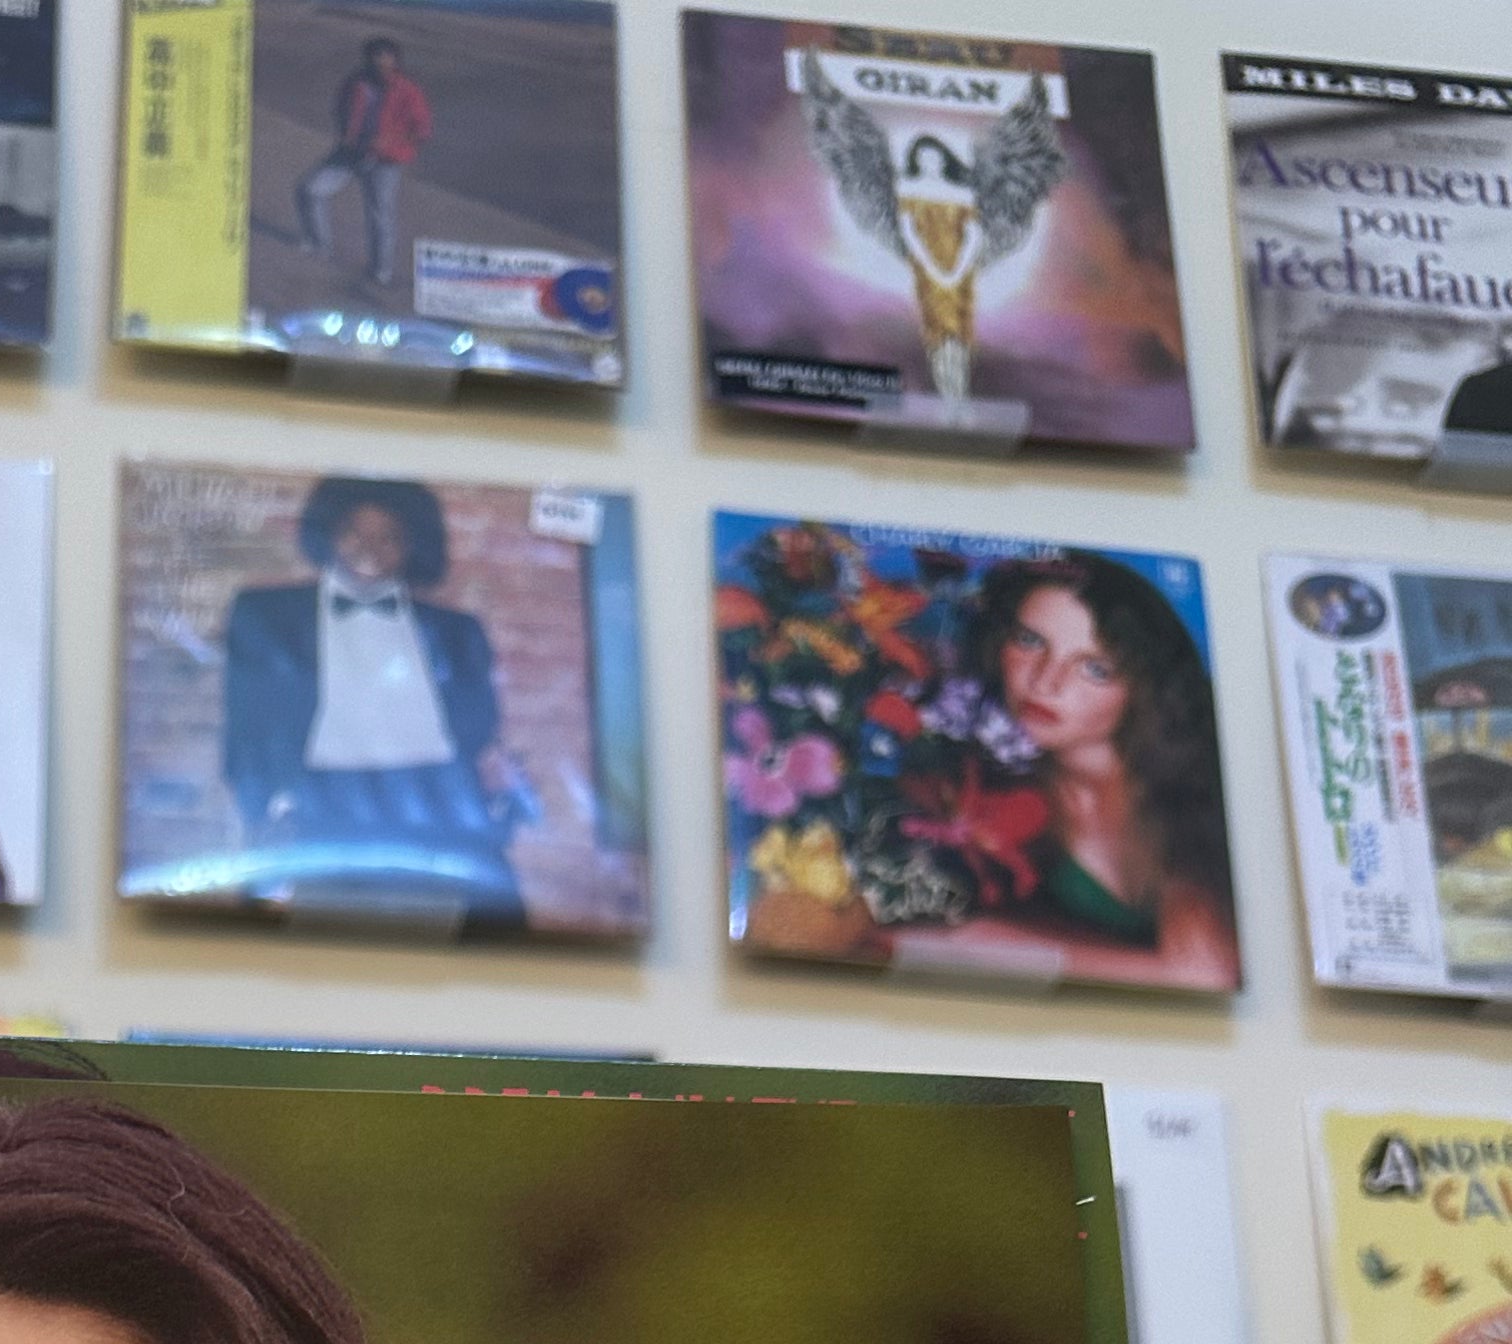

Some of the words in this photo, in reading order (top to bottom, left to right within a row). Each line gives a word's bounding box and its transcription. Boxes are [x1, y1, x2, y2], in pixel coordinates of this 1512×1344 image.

[854, 66, 999, 103] GIRAN
[1242, 64, 1418, 100] MILES
[1437, 82, 1512, 108] DA
[1341, 205, 1448, 245] pour
